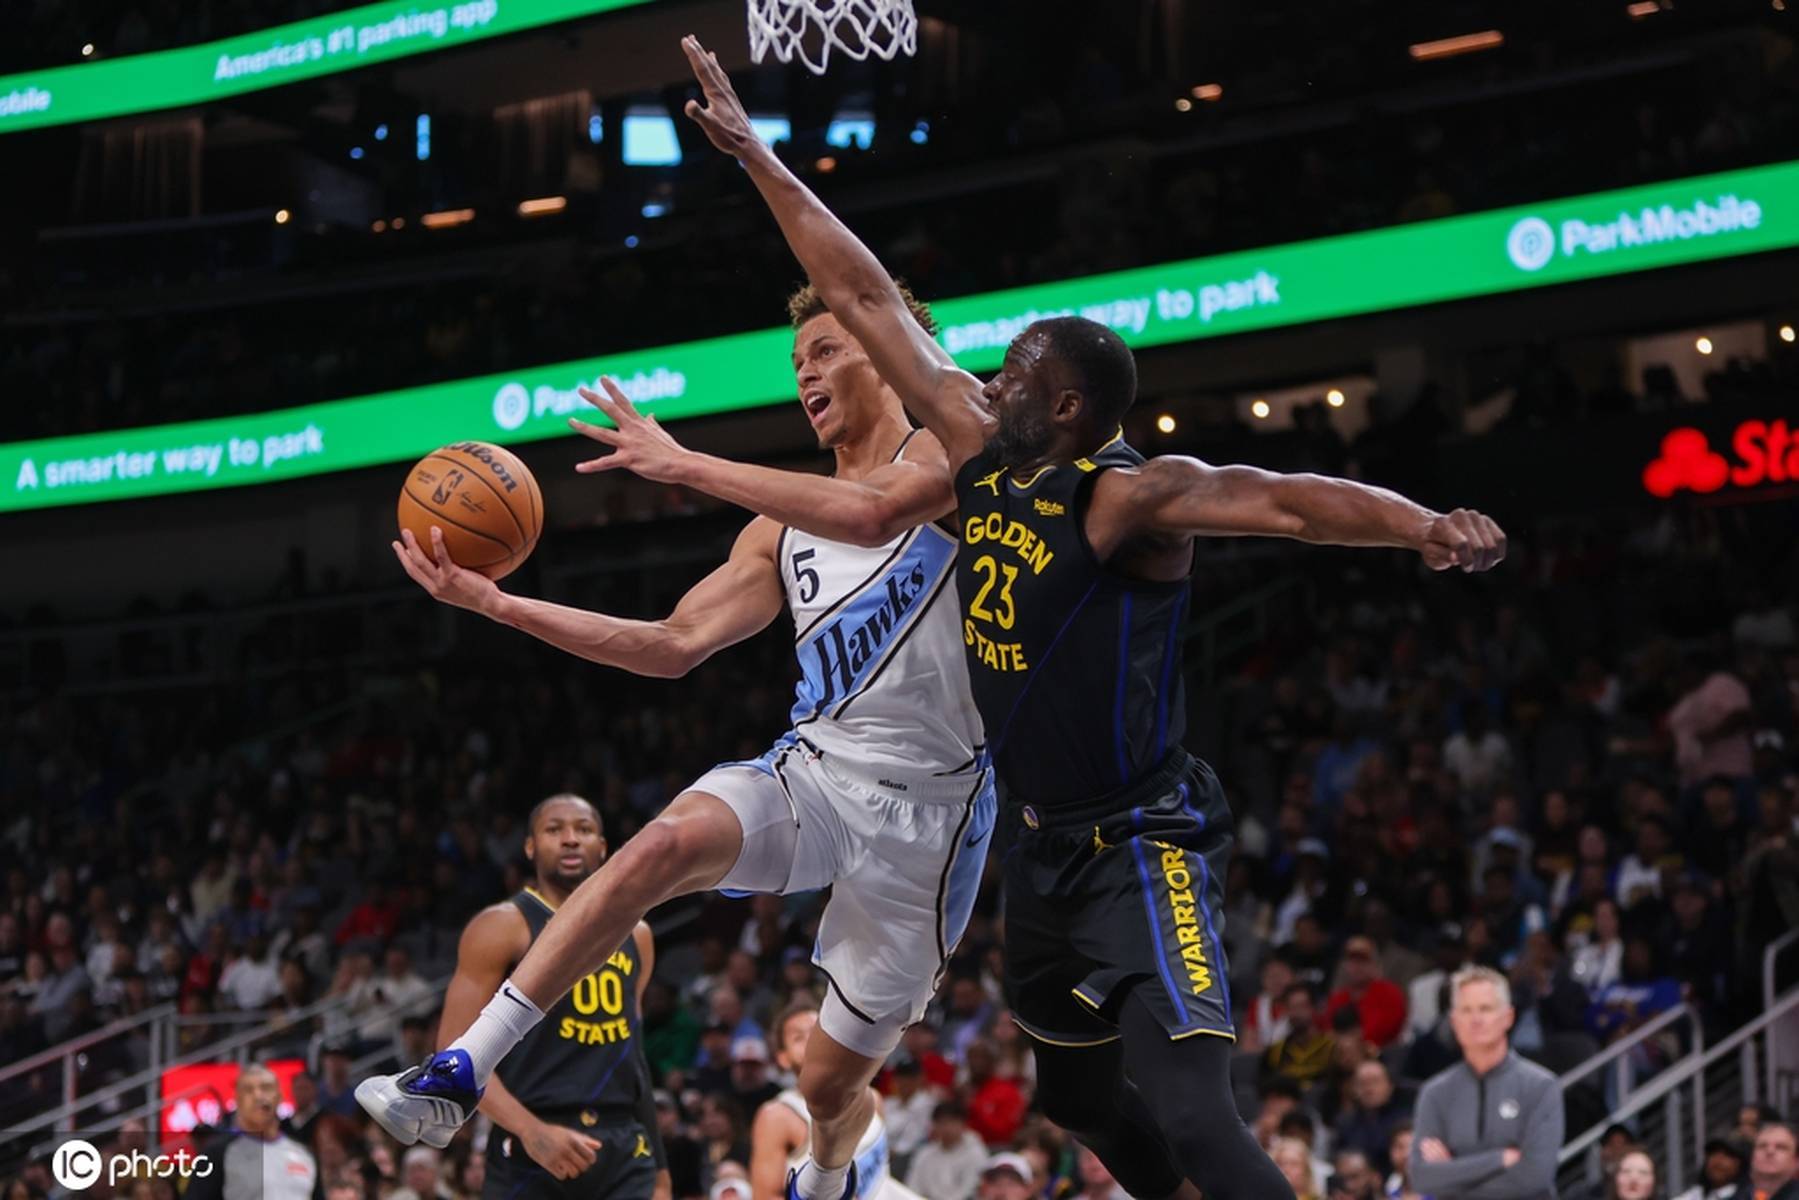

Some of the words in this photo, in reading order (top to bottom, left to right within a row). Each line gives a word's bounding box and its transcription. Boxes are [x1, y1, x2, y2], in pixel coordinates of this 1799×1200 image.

[215, 37, 324, 80] America's
[357, 9, 448, 52] parking
[451, 0, 498, 29] app
[1562, 195, 1761, 256] ParkMobile
[1156, 289, 1193, 320] to
[1199, 270, 1279, 322] park
[16, 458, 38, 490] A
[44, 451, 156, 487] smarter
[162, 444, 223, 476] way
[229, 438, 259, 465] to
[263, 424, 323, 468] park
[965, 512, 1055, 575] GODEN
[792, 548, 820, 604] 5
[970, 555, 1018, 630] 23
[813, 559, 925, 716] Hawks
[965, 619, 1028, 671] STATE
[573, 970, 623, 1015] 00
[559, 1017, 631, 1045] STATE
